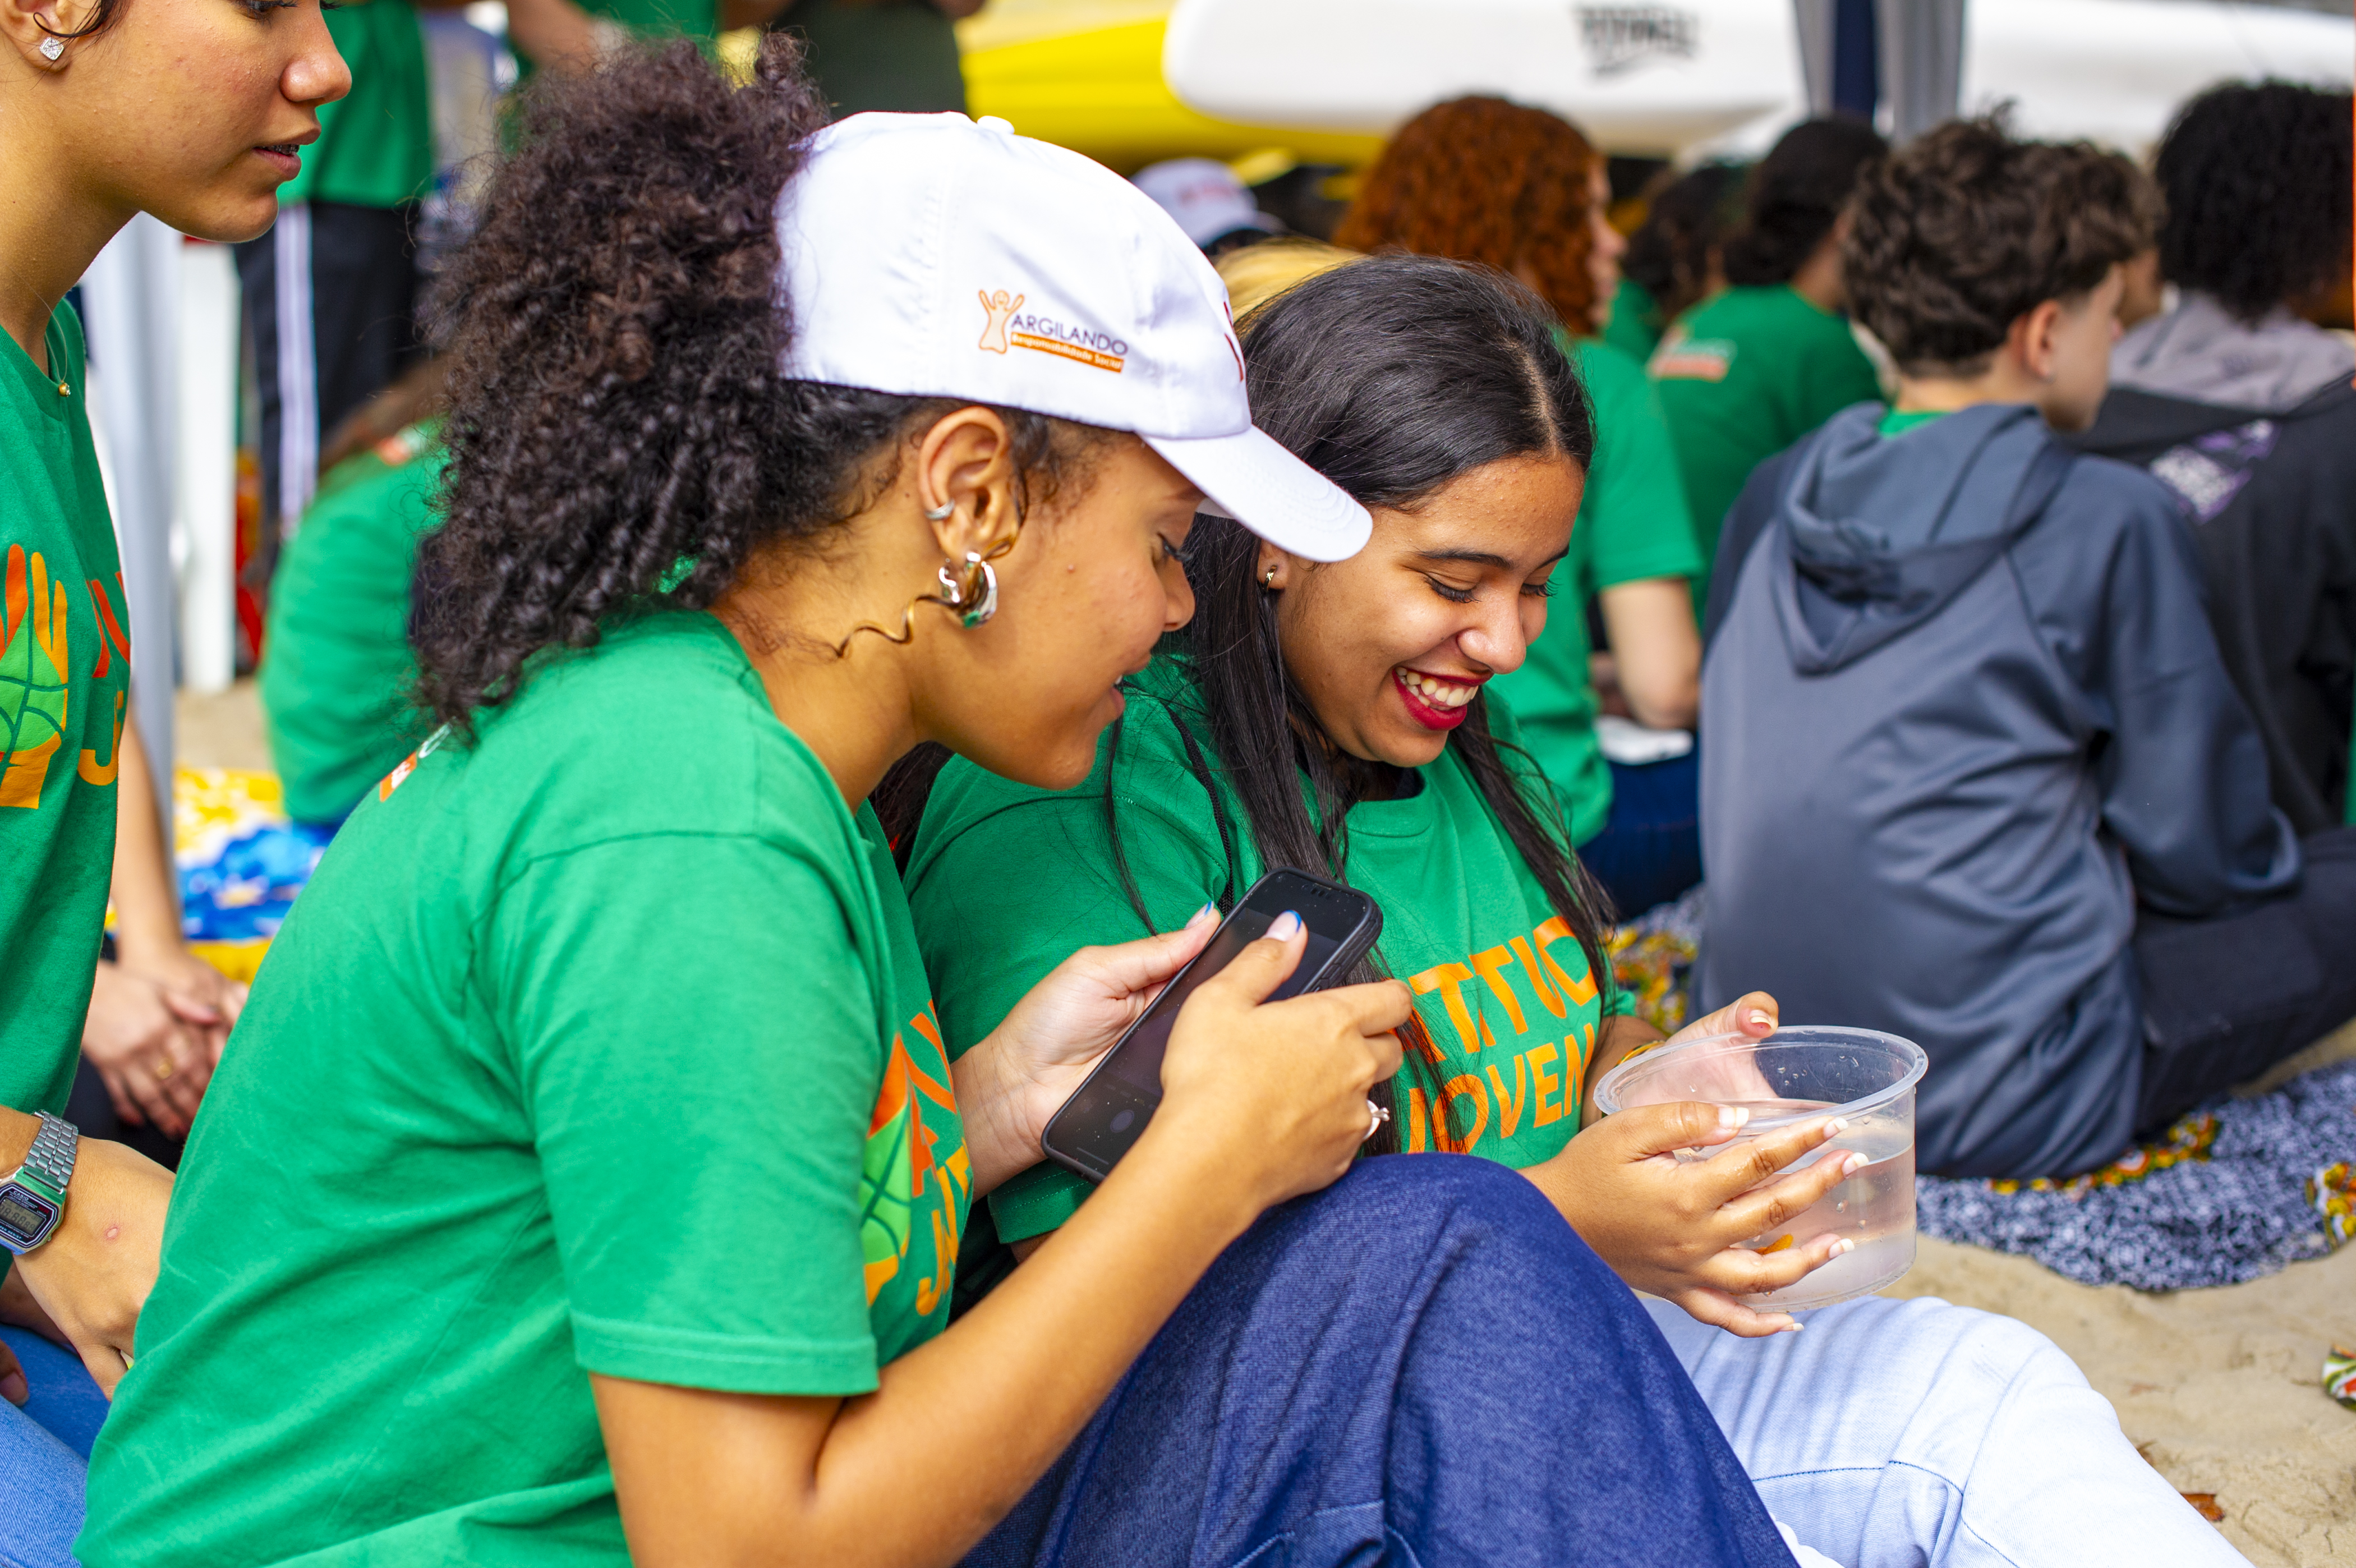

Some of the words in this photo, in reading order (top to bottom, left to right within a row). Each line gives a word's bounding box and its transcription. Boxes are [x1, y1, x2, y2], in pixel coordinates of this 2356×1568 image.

[1011, 314, 1129, 356] ARGILANDO
[1094, 353, 1121, 370] Social
[13, 1190, 29, 1201] CASIO
